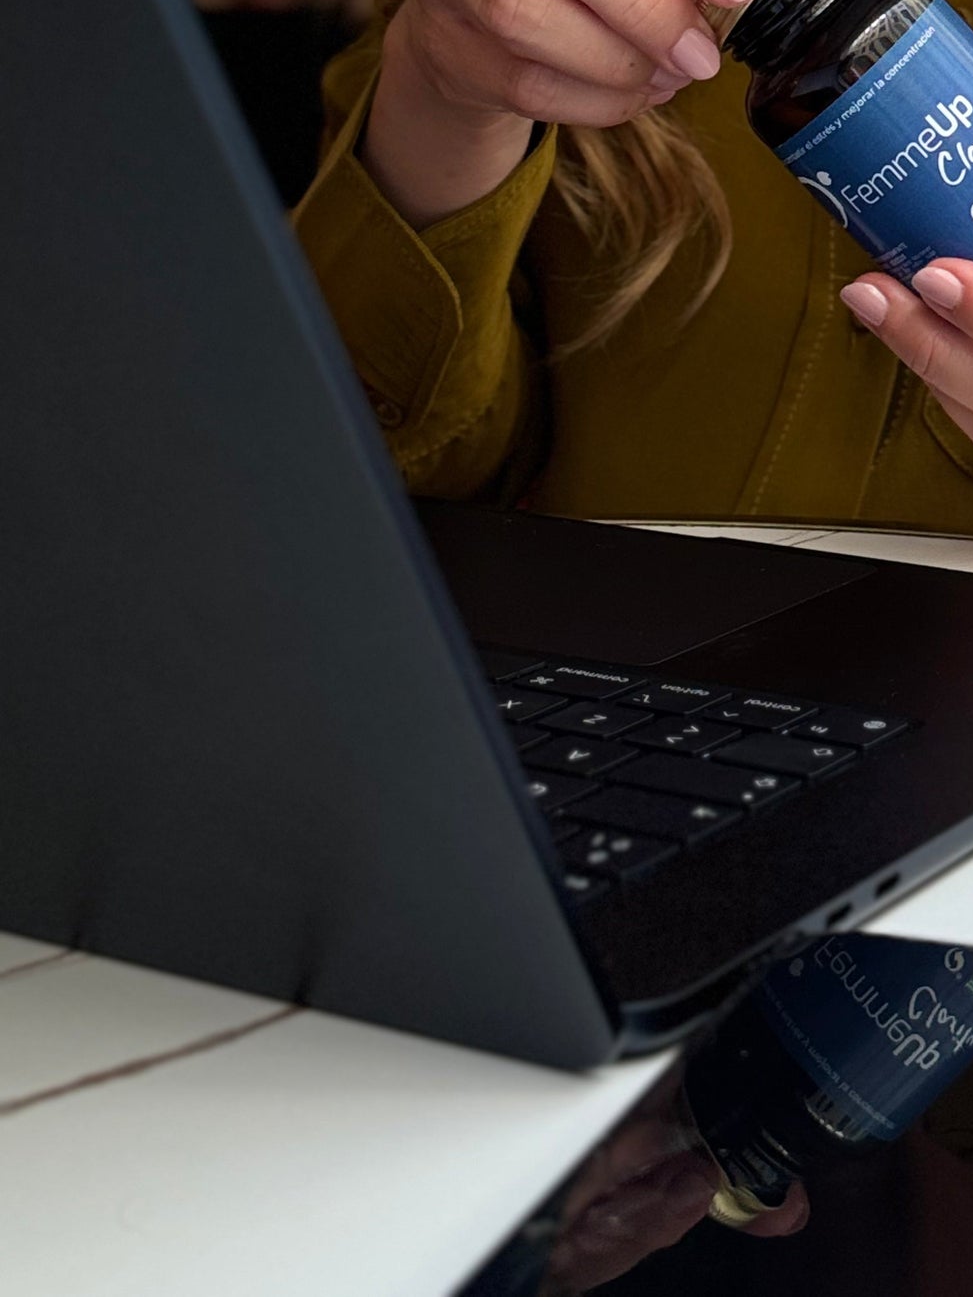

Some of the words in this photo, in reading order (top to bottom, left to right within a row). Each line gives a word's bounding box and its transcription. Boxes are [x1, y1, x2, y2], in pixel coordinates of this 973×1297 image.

[804, 140, 813, 150] el
[812, 122, 836, 145] estrés
[835, 118, 843, 129] y
[841, 88, 875, 121] mejorar
[873, 78, 885, 90] la
[884, 25, 935, 81] concentración
[840, 94, 973, 213] FemmeUp
[555, 667, 630, 683] command
[660, 683, 711, 697] option
[744, 698, 801, 713] control
[581, 714, 608, 725] Z
[568, 749, 591, 761] A
